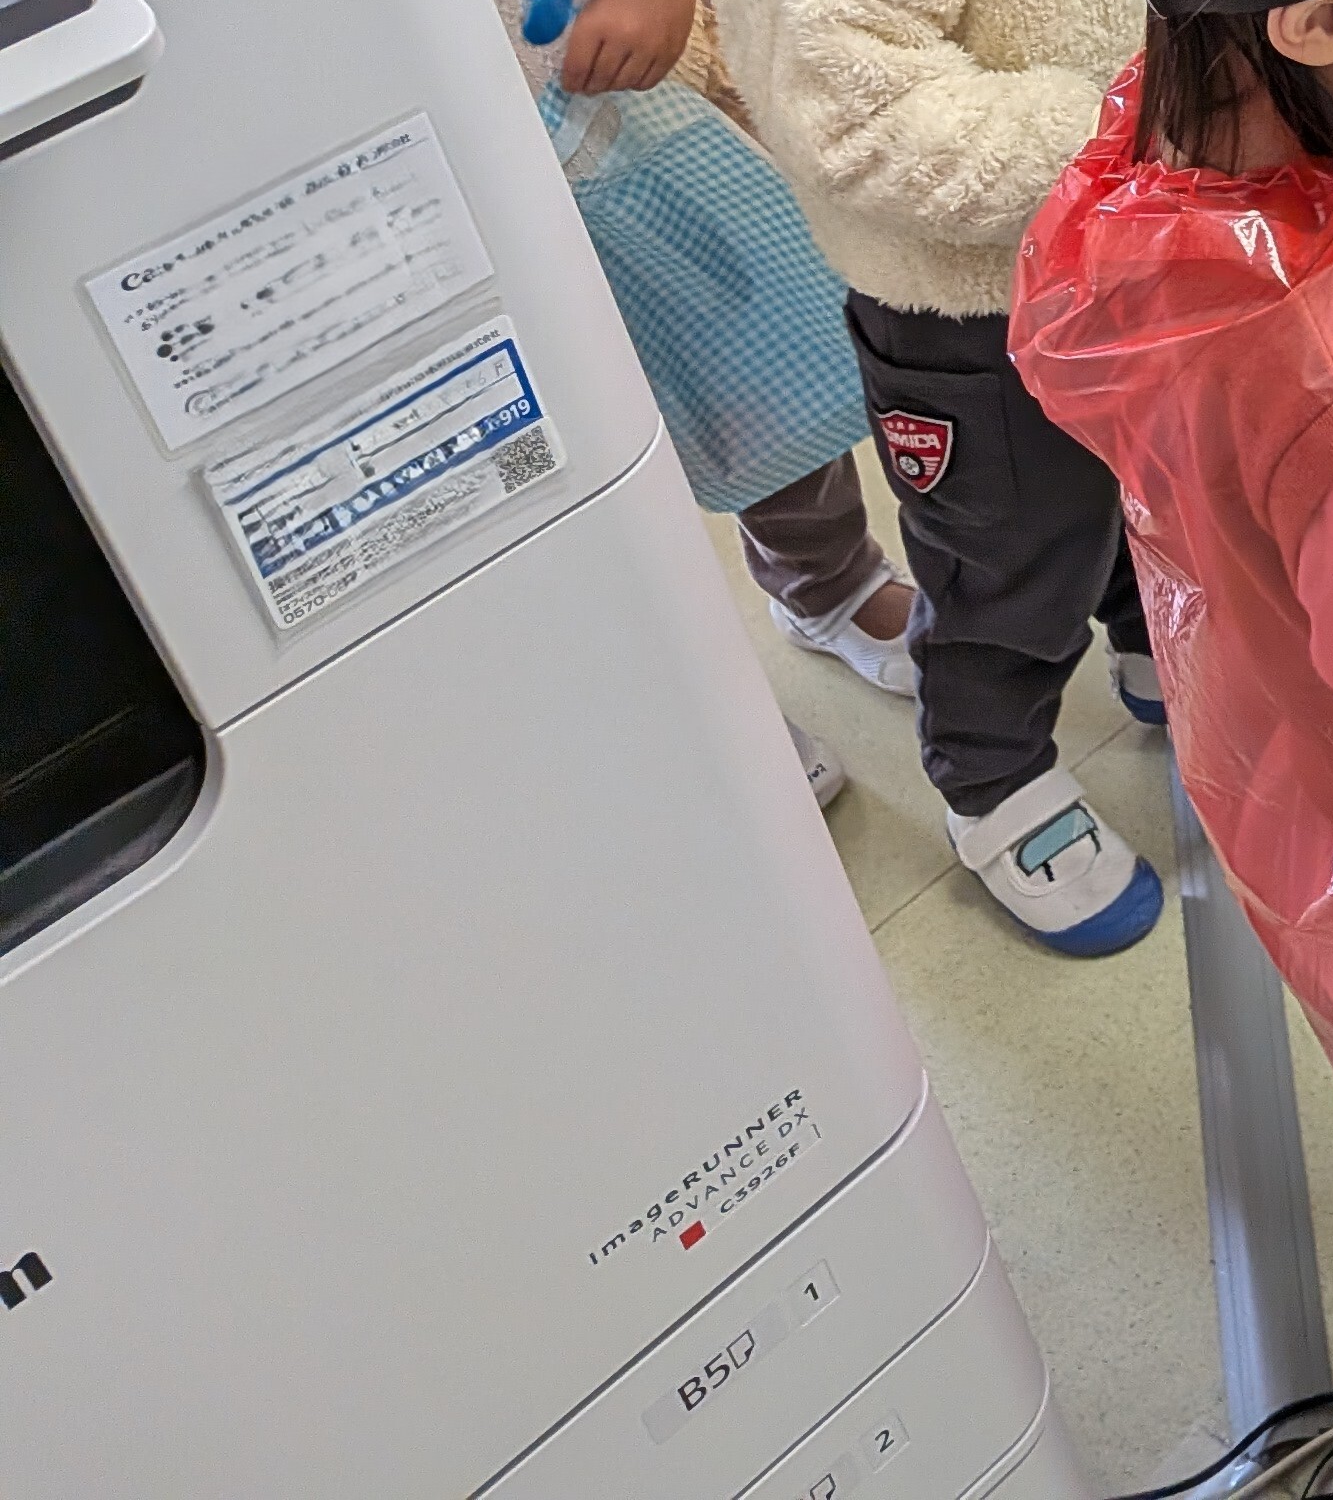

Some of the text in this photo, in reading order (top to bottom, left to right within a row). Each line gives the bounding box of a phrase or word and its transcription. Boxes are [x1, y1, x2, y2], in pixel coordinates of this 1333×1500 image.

[652, 1107, 809, 1243] ADVANCE DX
[677, 1282, 819, 1412] B5 1
[874, 1429, 895, 1453] 2
